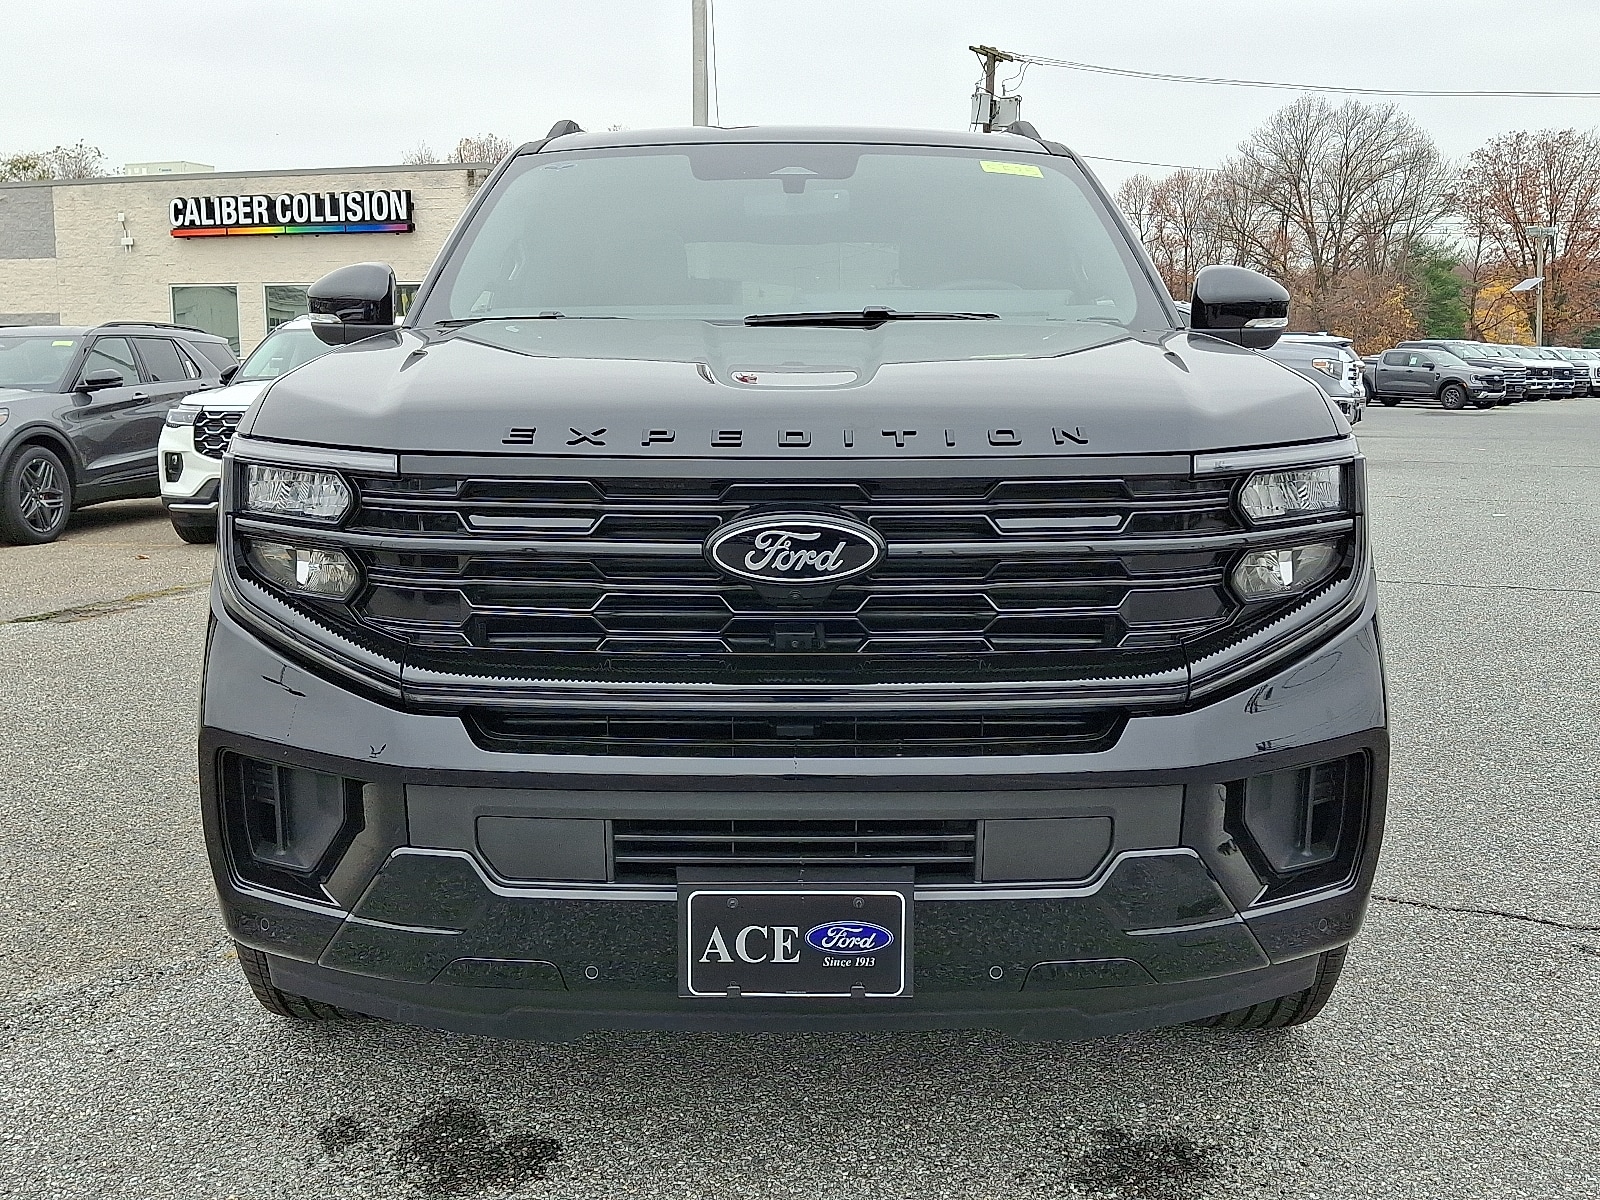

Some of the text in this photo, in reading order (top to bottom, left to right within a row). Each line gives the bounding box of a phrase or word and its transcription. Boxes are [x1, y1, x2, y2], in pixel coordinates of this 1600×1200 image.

[169, 190, 408, 226] CALIBER COLLISION
[501, 425, 1090, 449] EXPEDITION
[744, 530, 847, 572] Ford
[698, 925, 877, 964] ACE Ford
[822, 956, 876, 968] Since 1913
